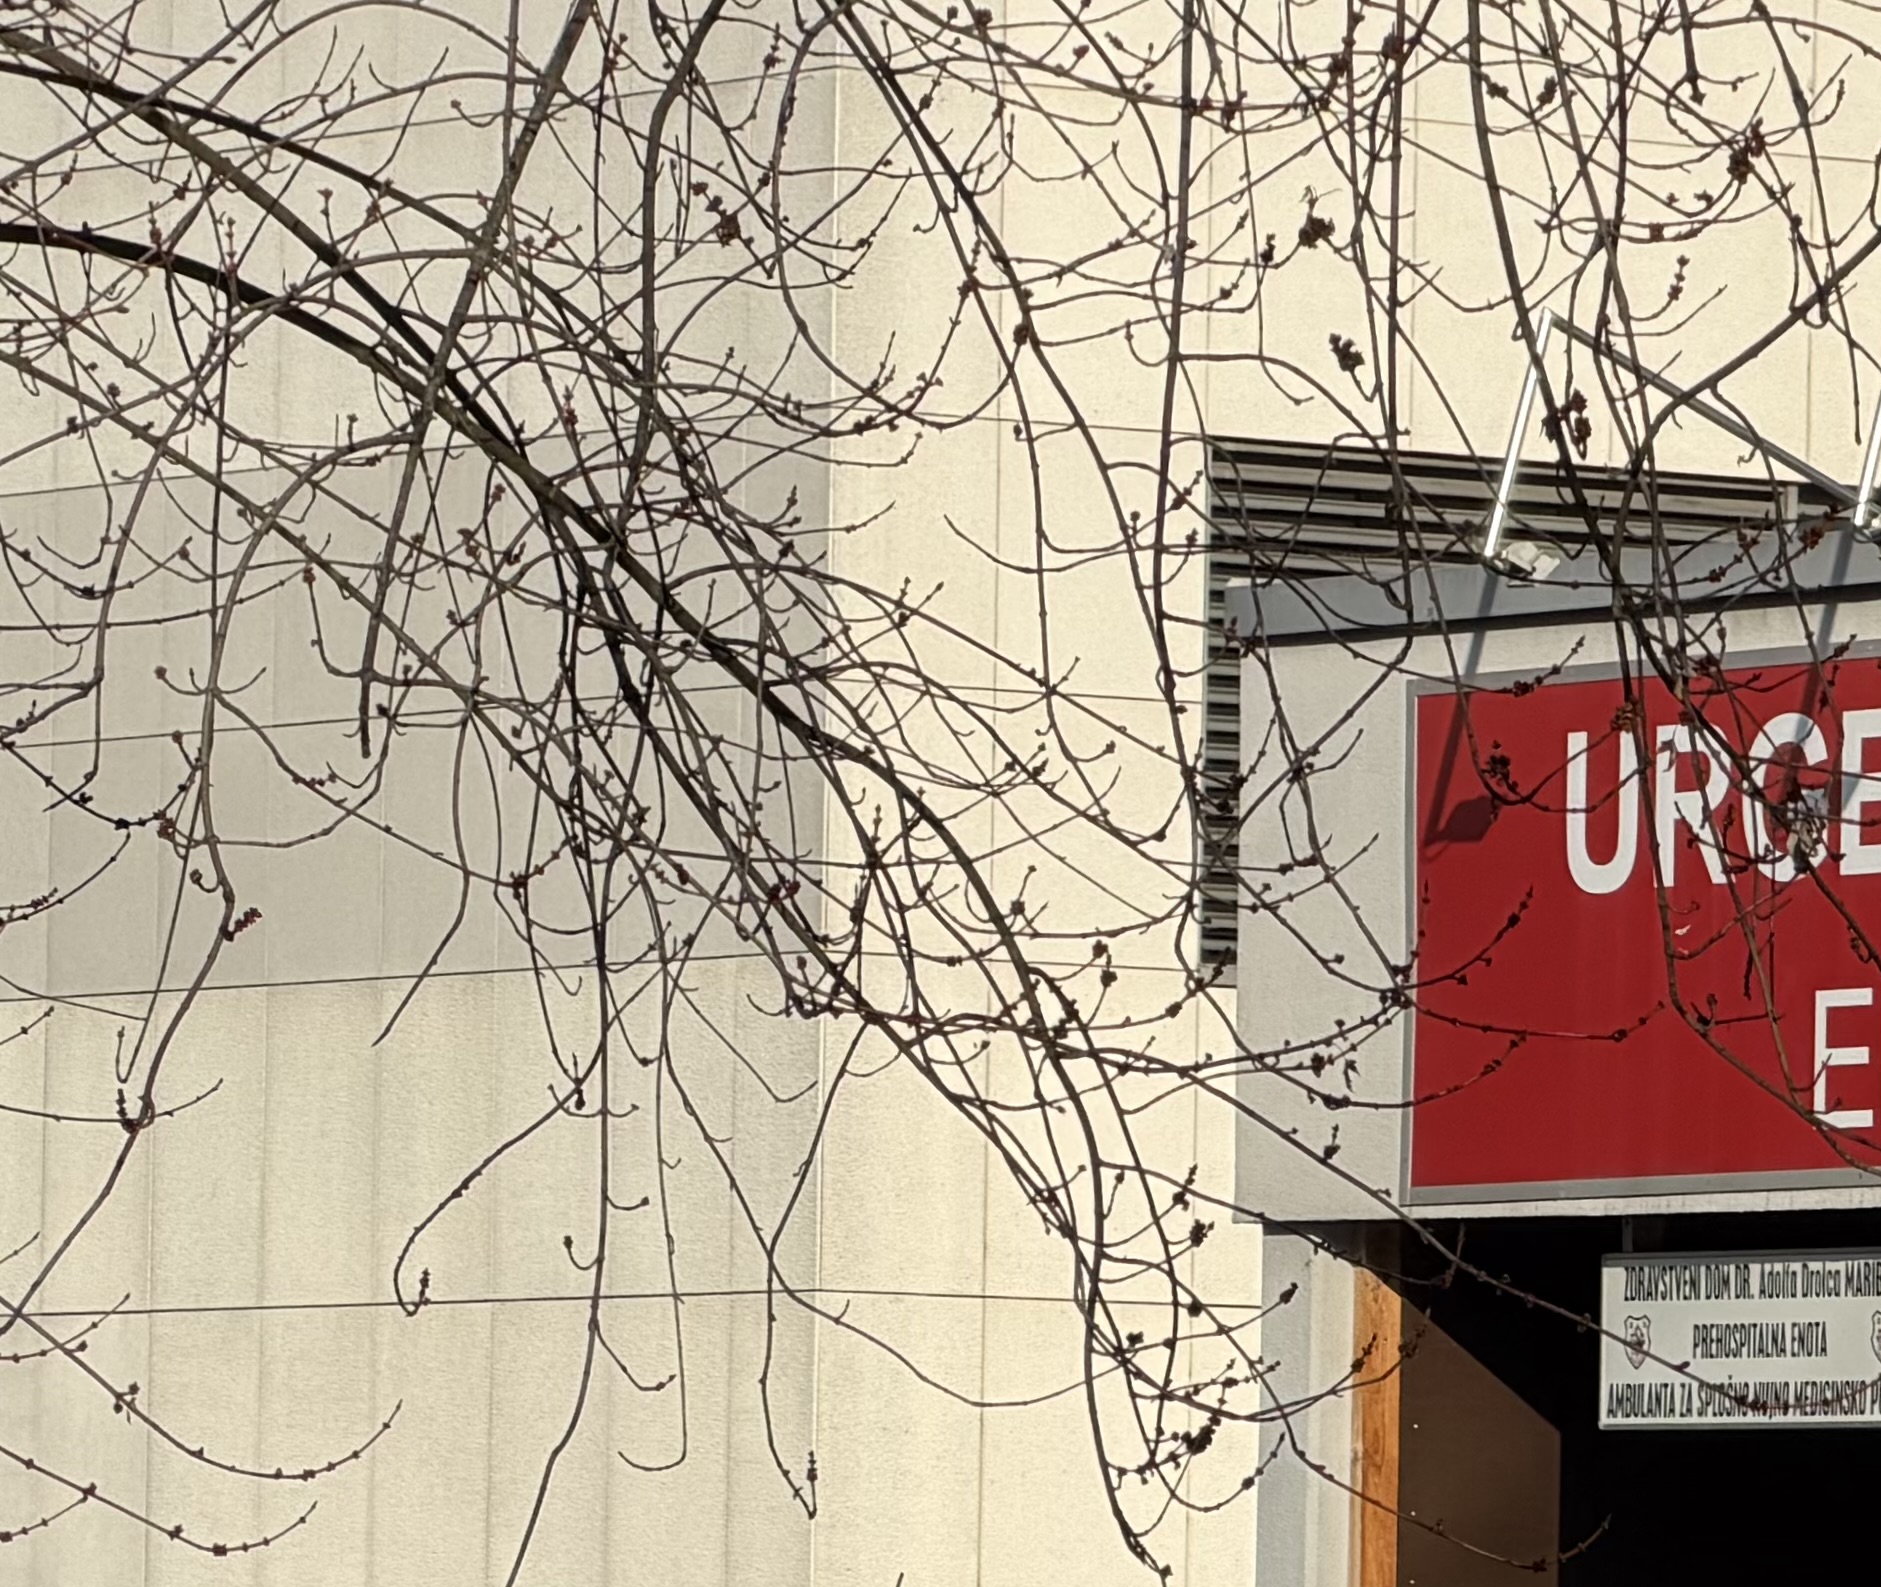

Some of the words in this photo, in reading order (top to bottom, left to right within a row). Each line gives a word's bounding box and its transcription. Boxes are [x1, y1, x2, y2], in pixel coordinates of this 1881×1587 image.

[1624, 1263, 1701, 1301] ZDRAVSTVENI
[1705, 1263, 1730, 1300] DOM
[1735, 1263, 1754, 1300] DR.
[1759, 1263, 1797, 1299] Adolfa
[1802, 1262, 1840, 1298] Drolca
[1693, 1322, 1787, 1359] PREHOSPITALNA
[1791, 1322, 1827, 1358] ENOTA
[1607, 1382, 1675, 1418] AMBULANTA
[1679, 1383, 1693, 1418] ZA
[1697, 1375, 1749, 1418] SPLOŠNO
[1753, 1381, 1789, 1419] NUJNO
[1794, 1379, 1866, 1417] MEDICINSKO
